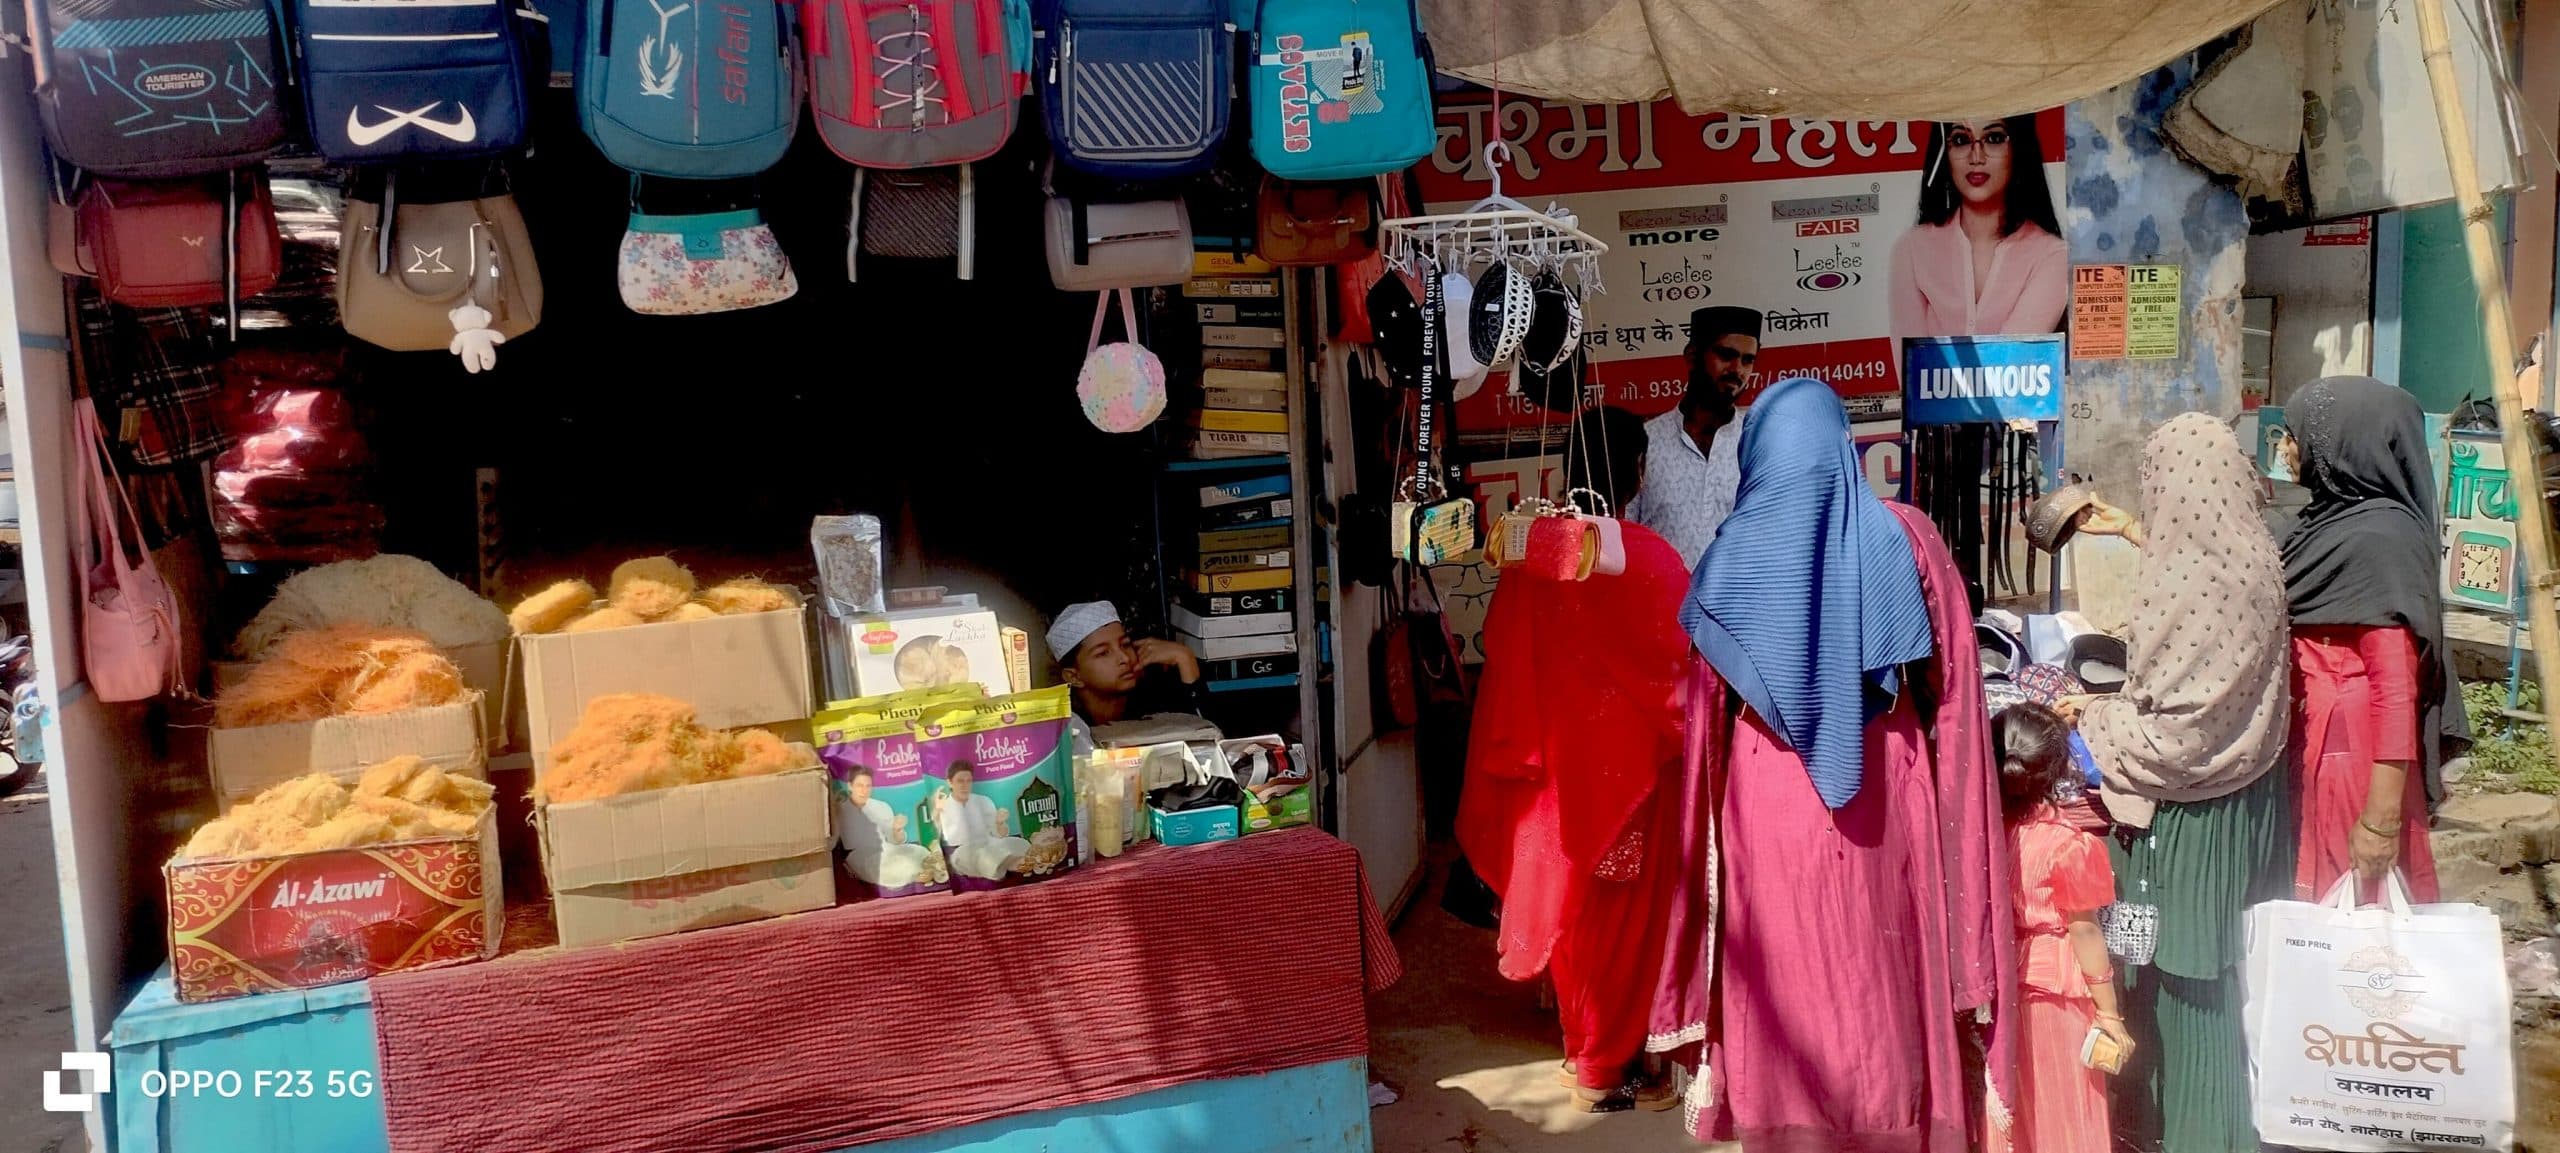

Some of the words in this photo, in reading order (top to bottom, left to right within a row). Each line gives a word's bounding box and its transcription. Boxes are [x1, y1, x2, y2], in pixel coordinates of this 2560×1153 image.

[717, 3, 750, 105] safari
[144, 71, 205, 84] AMERICAN
[145, 79, 205, 92] TOURISTER
[1277, 34, 1312, 152] SKYBAGS
[1628, 228, 1720, 247] more
[1797, 220, 1858, 236] FAIR
[1426, 268, 1435, 305] YOUNG
[2076, 268, 2104, 283] ITE
[2130, 268, 2158, 283] ITE
[2077, 295, 2123, 304] ADMISSION
[2090, 305, 2109, 313] FREE
[2131, 295, 2176, 304] ADMISSION
[2144, 305, 2162, 313] FREE
[1423, 307, 1434, 356] FOREVER
[1765, 307, 1830, 333] विक्रेता
[1615, 327, 1645, 352] धूप
[1650, 318, 1675, 342] के
[1422, 364, 1432, 401] YOUNG
[1919, 363, 2052, 400] LUMINOUS
[1419, 404, 1431, 452] FOREVER
[973, 699, 1018, 715] Pheni
[271, 872, 387, 909] Al-Azawi
[2285, 937, 2306, 947] FIXED
[2308, 940, 2332, 951] PRICE
[2303, 1021, 2467, 1076] शान्ति
[2334, 1077, 2435, 1101] वस्त्रालय
[2289, 1112, 2315, 1127] मेन
[2349, 1123, 2405, 1140] लातेहार
[2410, 1127, 2486, 1148] (झारखण्ड)
